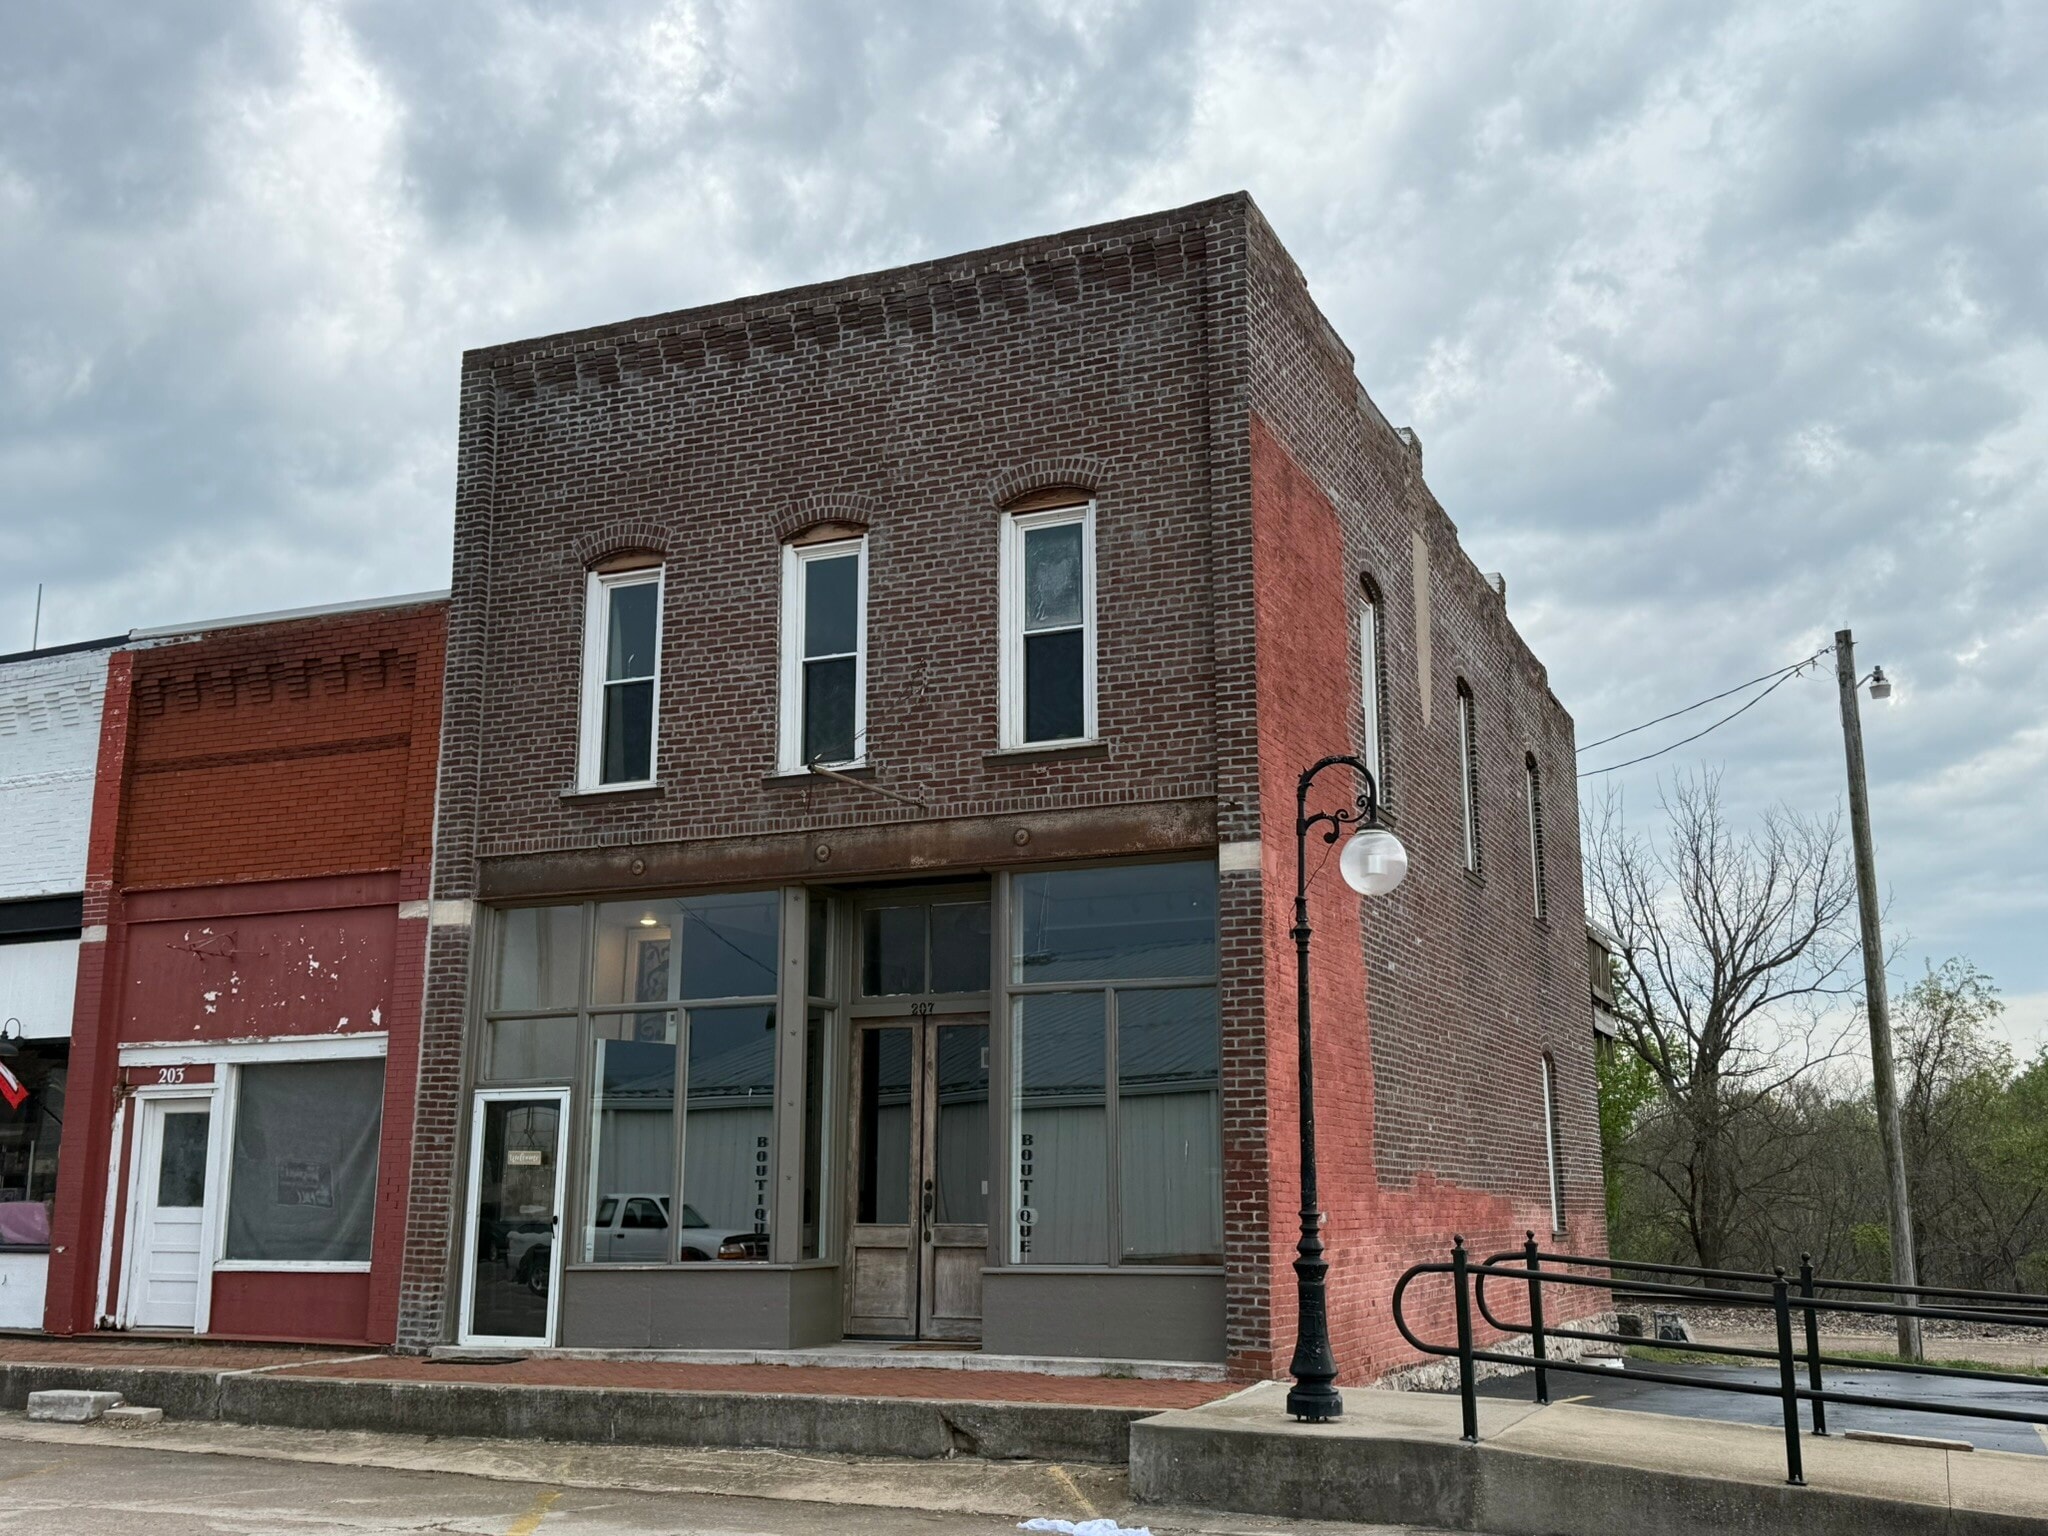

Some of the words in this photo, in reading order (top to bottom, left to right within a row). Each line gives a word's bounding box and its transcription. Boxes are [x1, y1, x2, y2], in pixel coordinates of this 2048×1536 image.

[911, 1002, 935, 1016] 207
[157, 1067, 186, 1084] 203
[754, 1136, 768, 1247] BOUTIQU
[1020, 1134, 1033, 1253] BOUTIQUE
